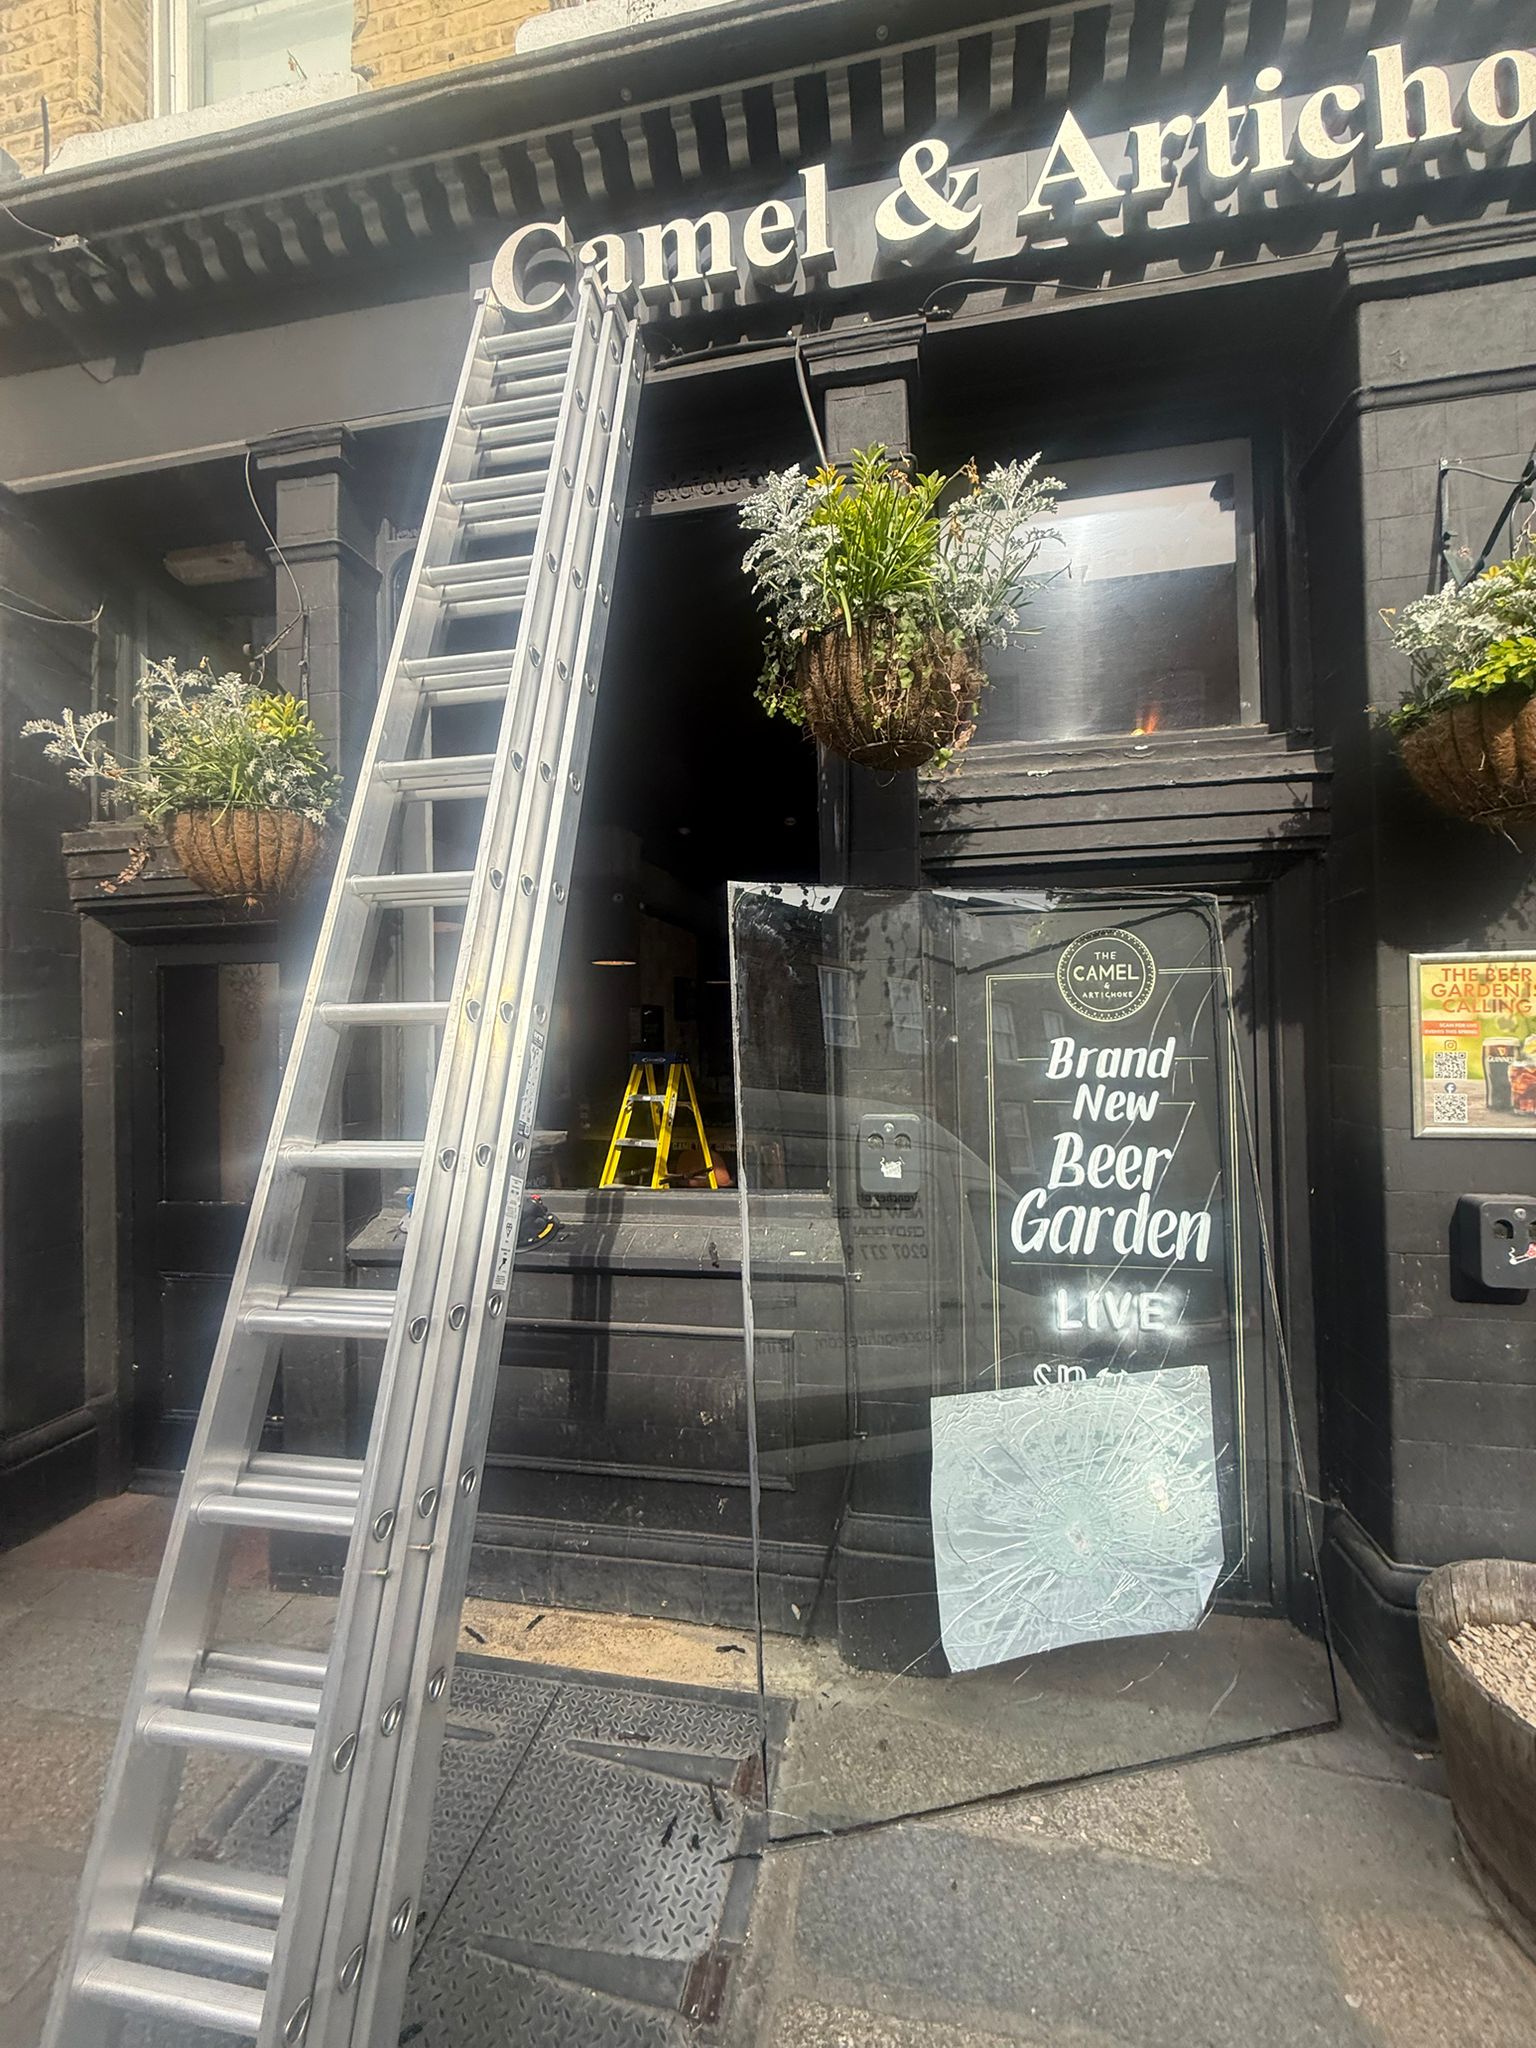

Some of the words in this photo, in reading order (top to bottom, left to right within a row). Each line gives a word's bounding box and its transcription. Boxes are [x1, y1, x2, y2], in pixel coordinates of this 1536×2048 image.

[491, 163, 834, 314] Camel
[876, 138, 983, 242] &
[1018, 44, 1536, 217] Articho
[1094, 951, 1117, 960] THE
[1073, 963, 1140, 982] CAMEL
[1441, 967, 1478, 982] THE
[1485, 967, 1532, 982] BEER
[1081, 990, 1134, 999] ARTICHOKE
[1103, 981, 1110, 989] &
[1431, 983, 1519, 998] GARDEN
[1442, 998, 1532, 1014] CALLING
[1045, 1036, 1176, 1080] Brand
[1072, 1083, 1160, 1122] New
[1047, 1131, 1173, 1191] Beer
[1011, 1187, 1211, 1263] Garden
[1057, 1289, 1166, 1331] LIVE
